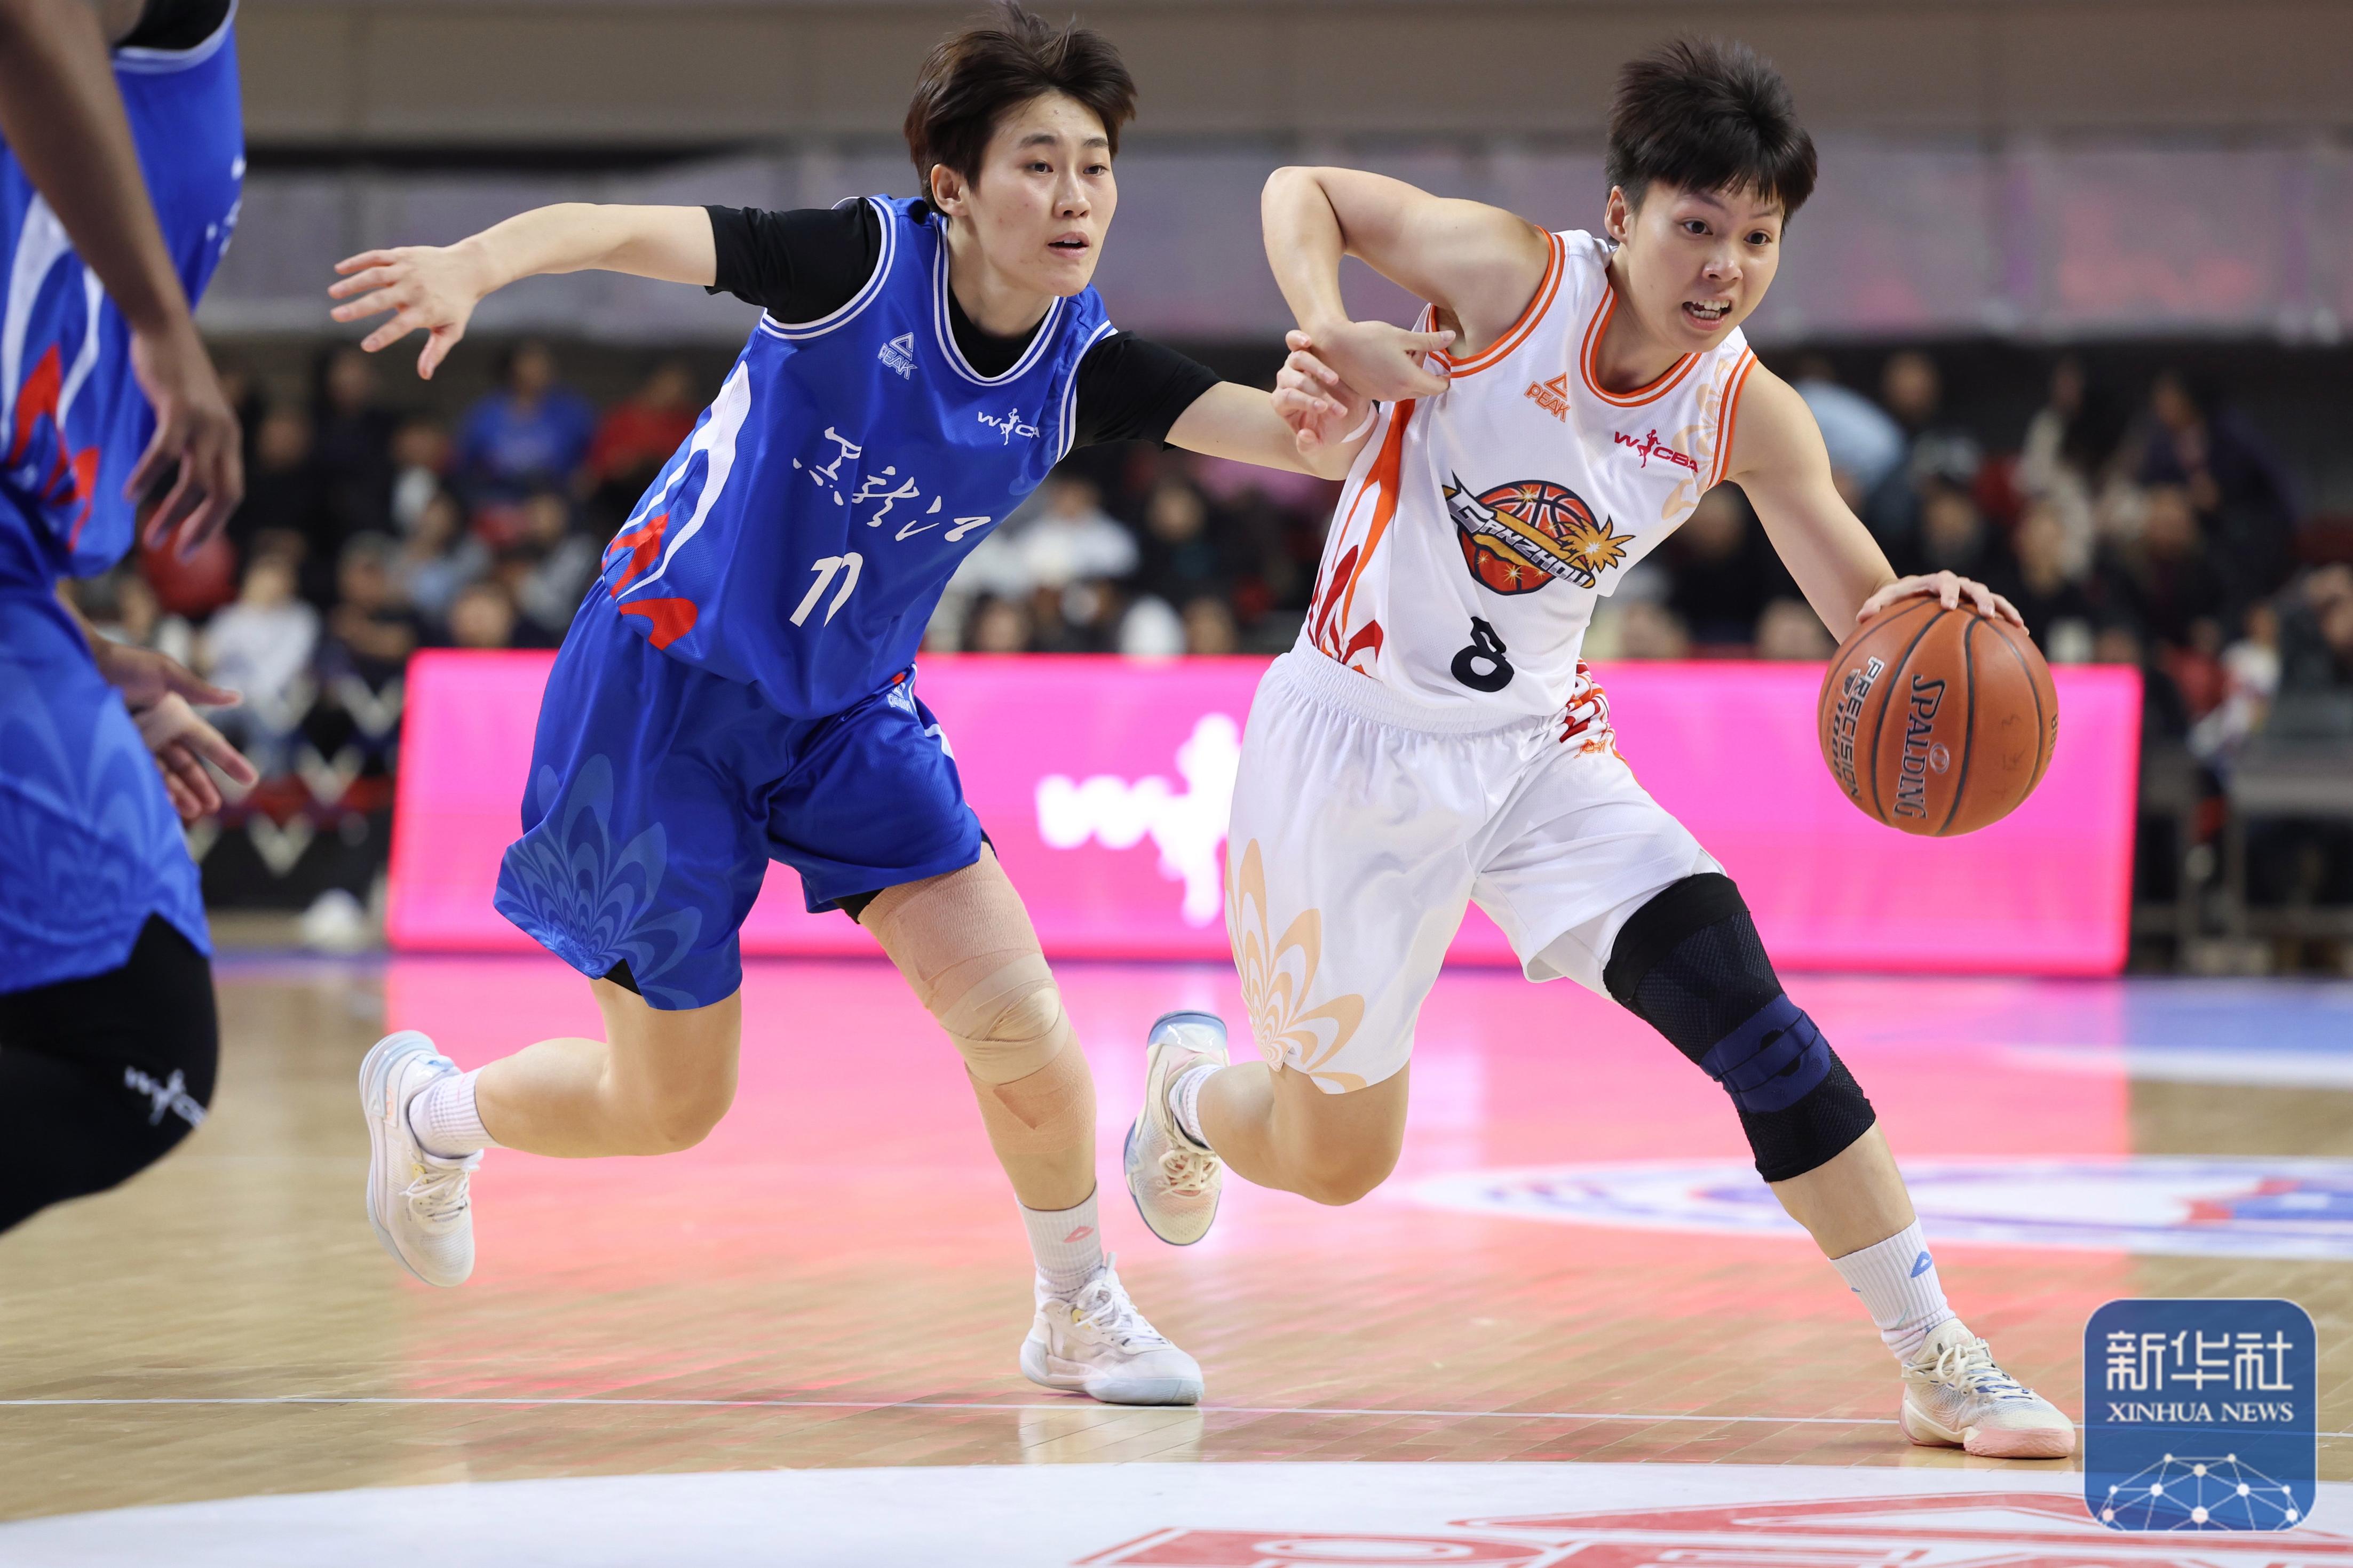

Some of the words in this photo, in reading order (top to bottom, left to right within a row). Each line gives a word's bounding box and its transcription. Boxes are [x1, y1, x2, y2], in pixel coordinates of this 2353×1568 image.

[877, 343, 918, 380] PEAK
[1524, 381, 1571, 423] PEAK
[1614, 430, 1699, 473] WCBA
[1445, 485, 1591, 586] GANZHOU
[1451, 616, 1514, 693] 8
[1840, 656, 1885, 802] PRECISION
[1892, 673, 1947, 820] SPALDING
